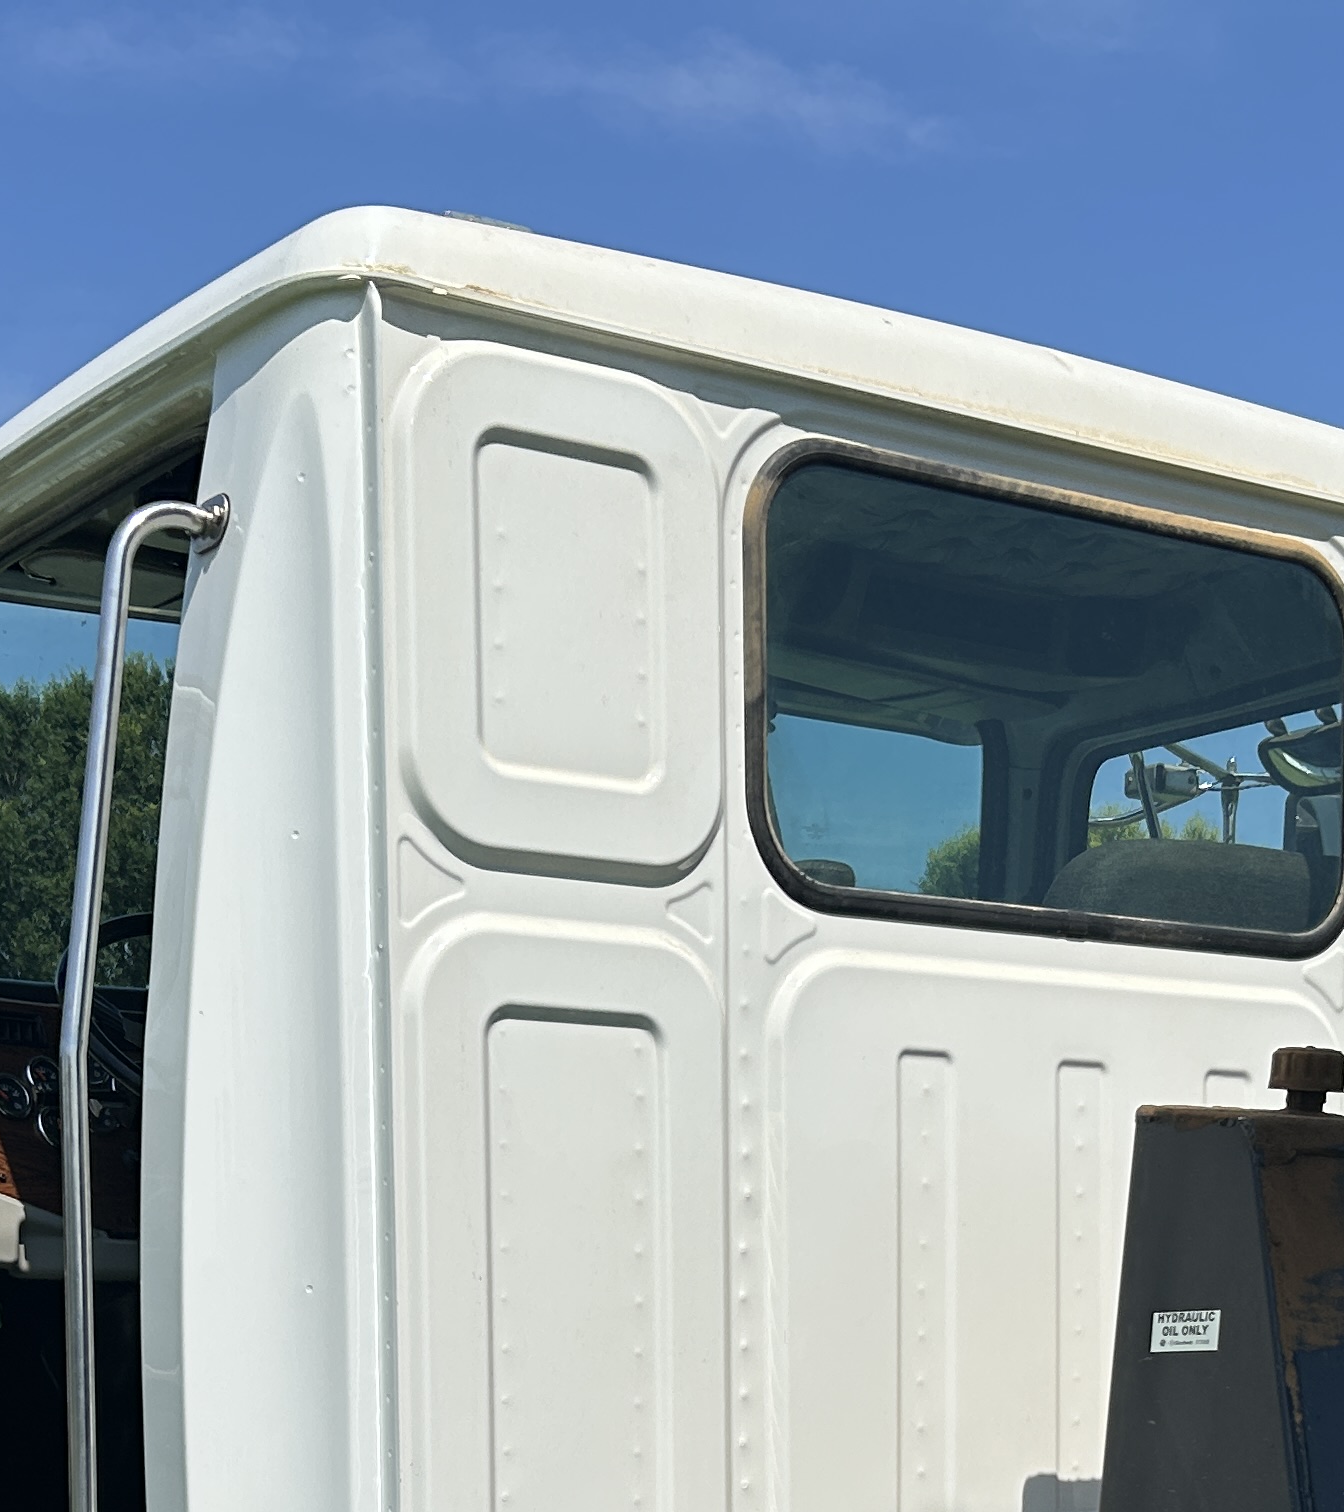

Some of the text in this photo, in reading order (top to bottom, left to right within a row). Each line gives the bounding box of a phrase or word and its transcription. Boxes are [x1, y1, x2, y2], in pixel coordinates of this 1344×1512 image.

[1157, 1312, 1216, 1323] HYDRAULIC
[1162, 1324, 1209, 1337] OIL ONLY
